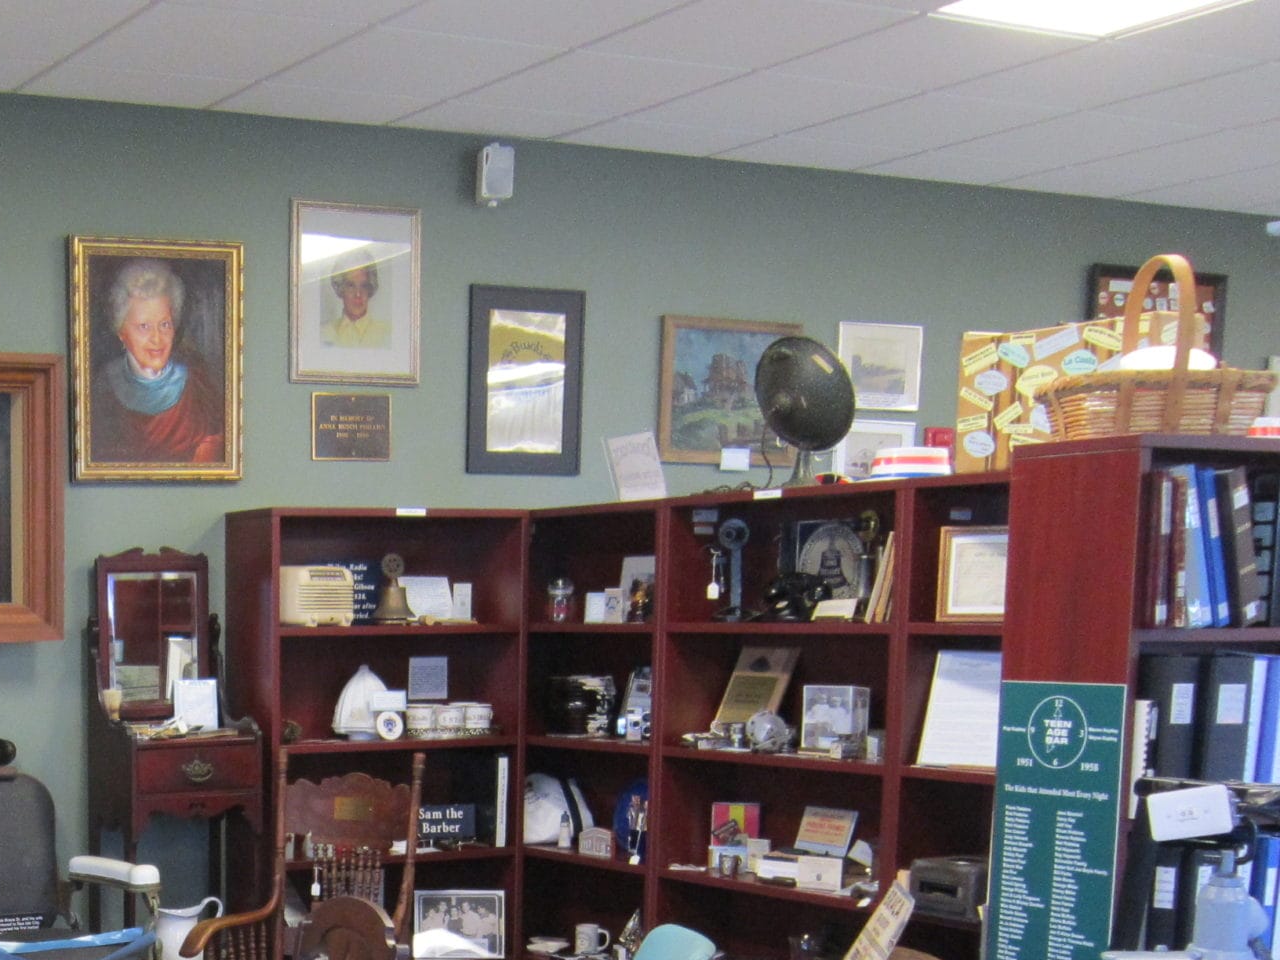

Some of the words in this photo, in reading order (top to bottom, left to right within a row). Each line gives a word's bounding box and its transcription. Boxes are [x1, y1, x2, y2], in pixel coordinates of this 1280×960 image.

[1044, 719, 1072, 728] TEEN
[1046, 728, 1068, 737] AGE
[1045, 737, 1069, 745] BAR
[419, 807, 442, 820] Sam
[446, 807, 463, 819] the
[423, 822, 461, 833] Barber
